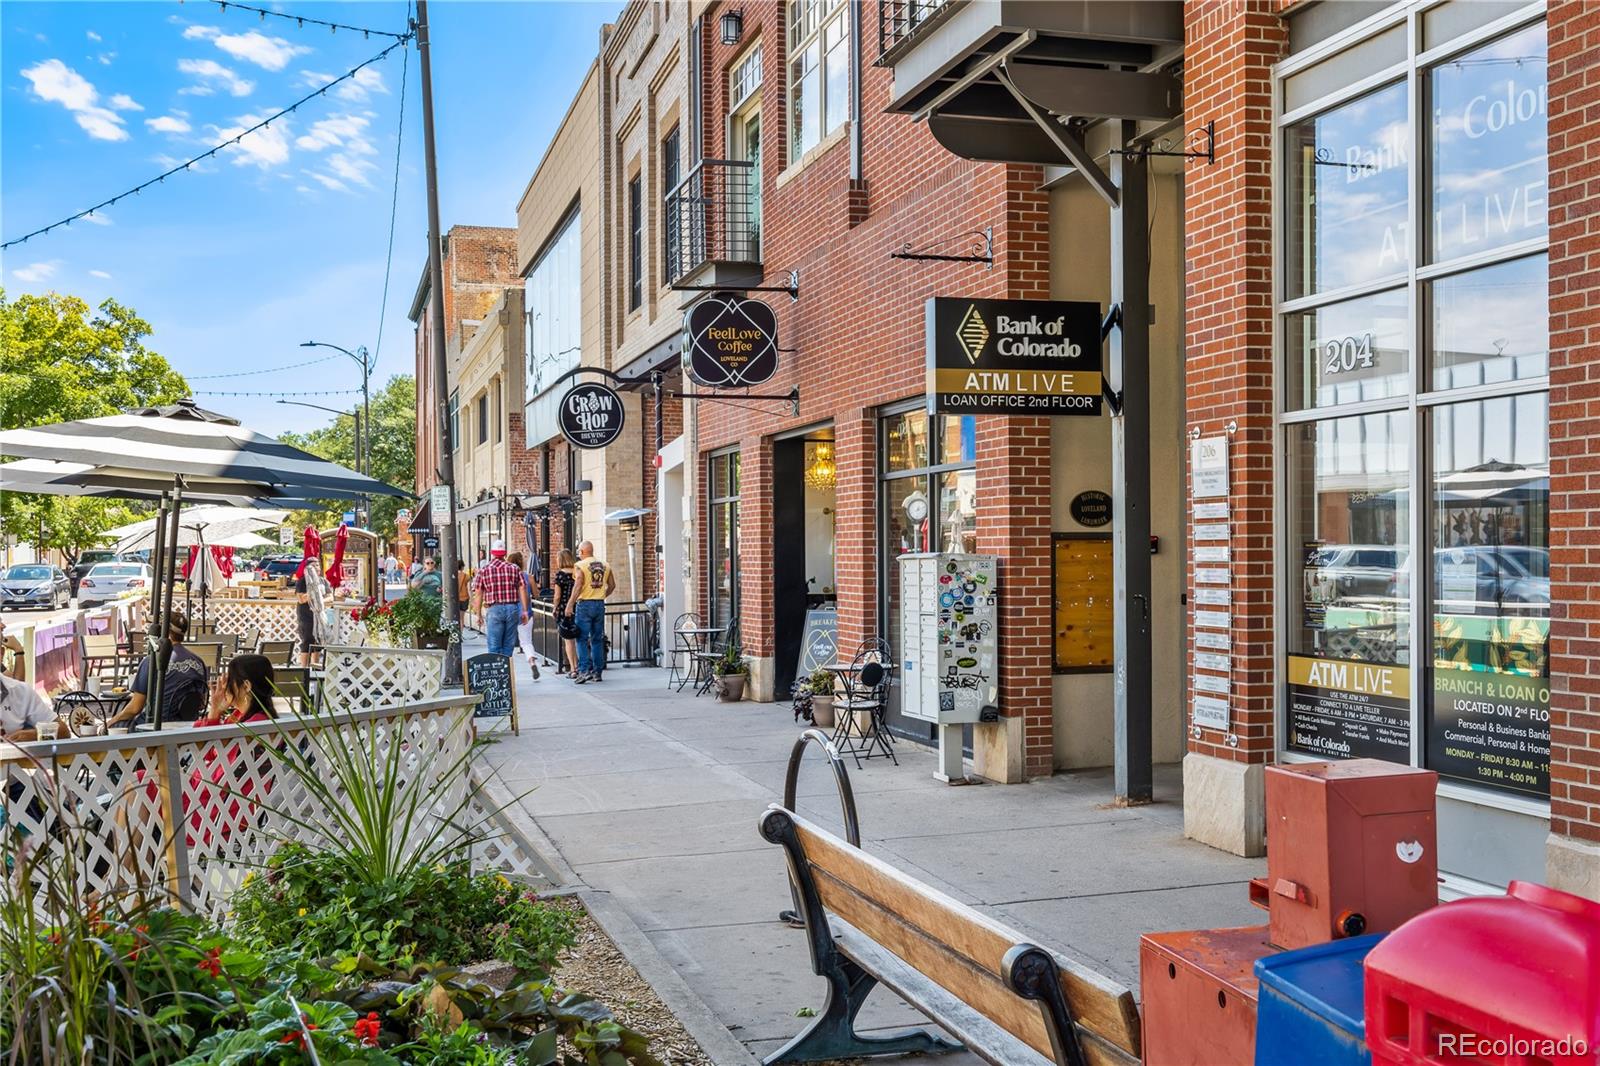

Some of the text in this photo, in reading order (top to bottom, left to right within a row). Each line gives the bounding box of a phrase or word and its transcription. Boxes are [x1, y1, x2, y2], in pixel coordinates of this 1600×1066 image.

[1346, 126, 1408, 184] Bank
[1462, 180, 1545, 244] LIVE
[708, 327, 761, 340] FeelLove
[997, 316, 1065, 336] Bank of
[717, 341, 752, 353] Coffee
[997, 337, 1081, 357] Colorado
[1325, 332, 1374, 375] 204
[964, 372, 1074, 392] ATM LIVE
[569, 391, 613, 414] CROW
[944, 395, 1093, 408] LOAN OFFICE 2nd FLOOR
[576, 412, 609, 432] HOP
[1202, 444, 1216, 458] 206
[473, 672, 498, 688] honey
[1308, 662, 1393, 694] ATM LIVE
[1435, 678, 1482, 696] BRANCH
[1487, 682, 1495, 697] &
[1499, 684, 1535, 701] LOAN
[1320, 700, 1341, 709] CONNECT
[1454, 699, 1550, 722] LOCATED ON 2nd FLO
[1390, 730, 1408, 739] Payments
[1458, 719, 1487, 731] Personal
[1489, 723, 1495, 732] &
[1496, 724, 1526, 737] Business
[1298, 734, 1350, 753] Bank of Colorado
[1445, 730, 1550, 755] Commercial, Personal & Home
[1446, 748, 1474, 759] MONDAY
[1481, 753, 1504, 765] FRIDAY
[1506, 758, 1520, 767] 8:30
[1521, 760, 1533, 770] AM
[1478, 767, 1491, 776] 1:30
[1493, 770, 1504, 779] PM
[1510, 772, 1524, 781] 4:00
[1526, 775, 1536, 784] PM
